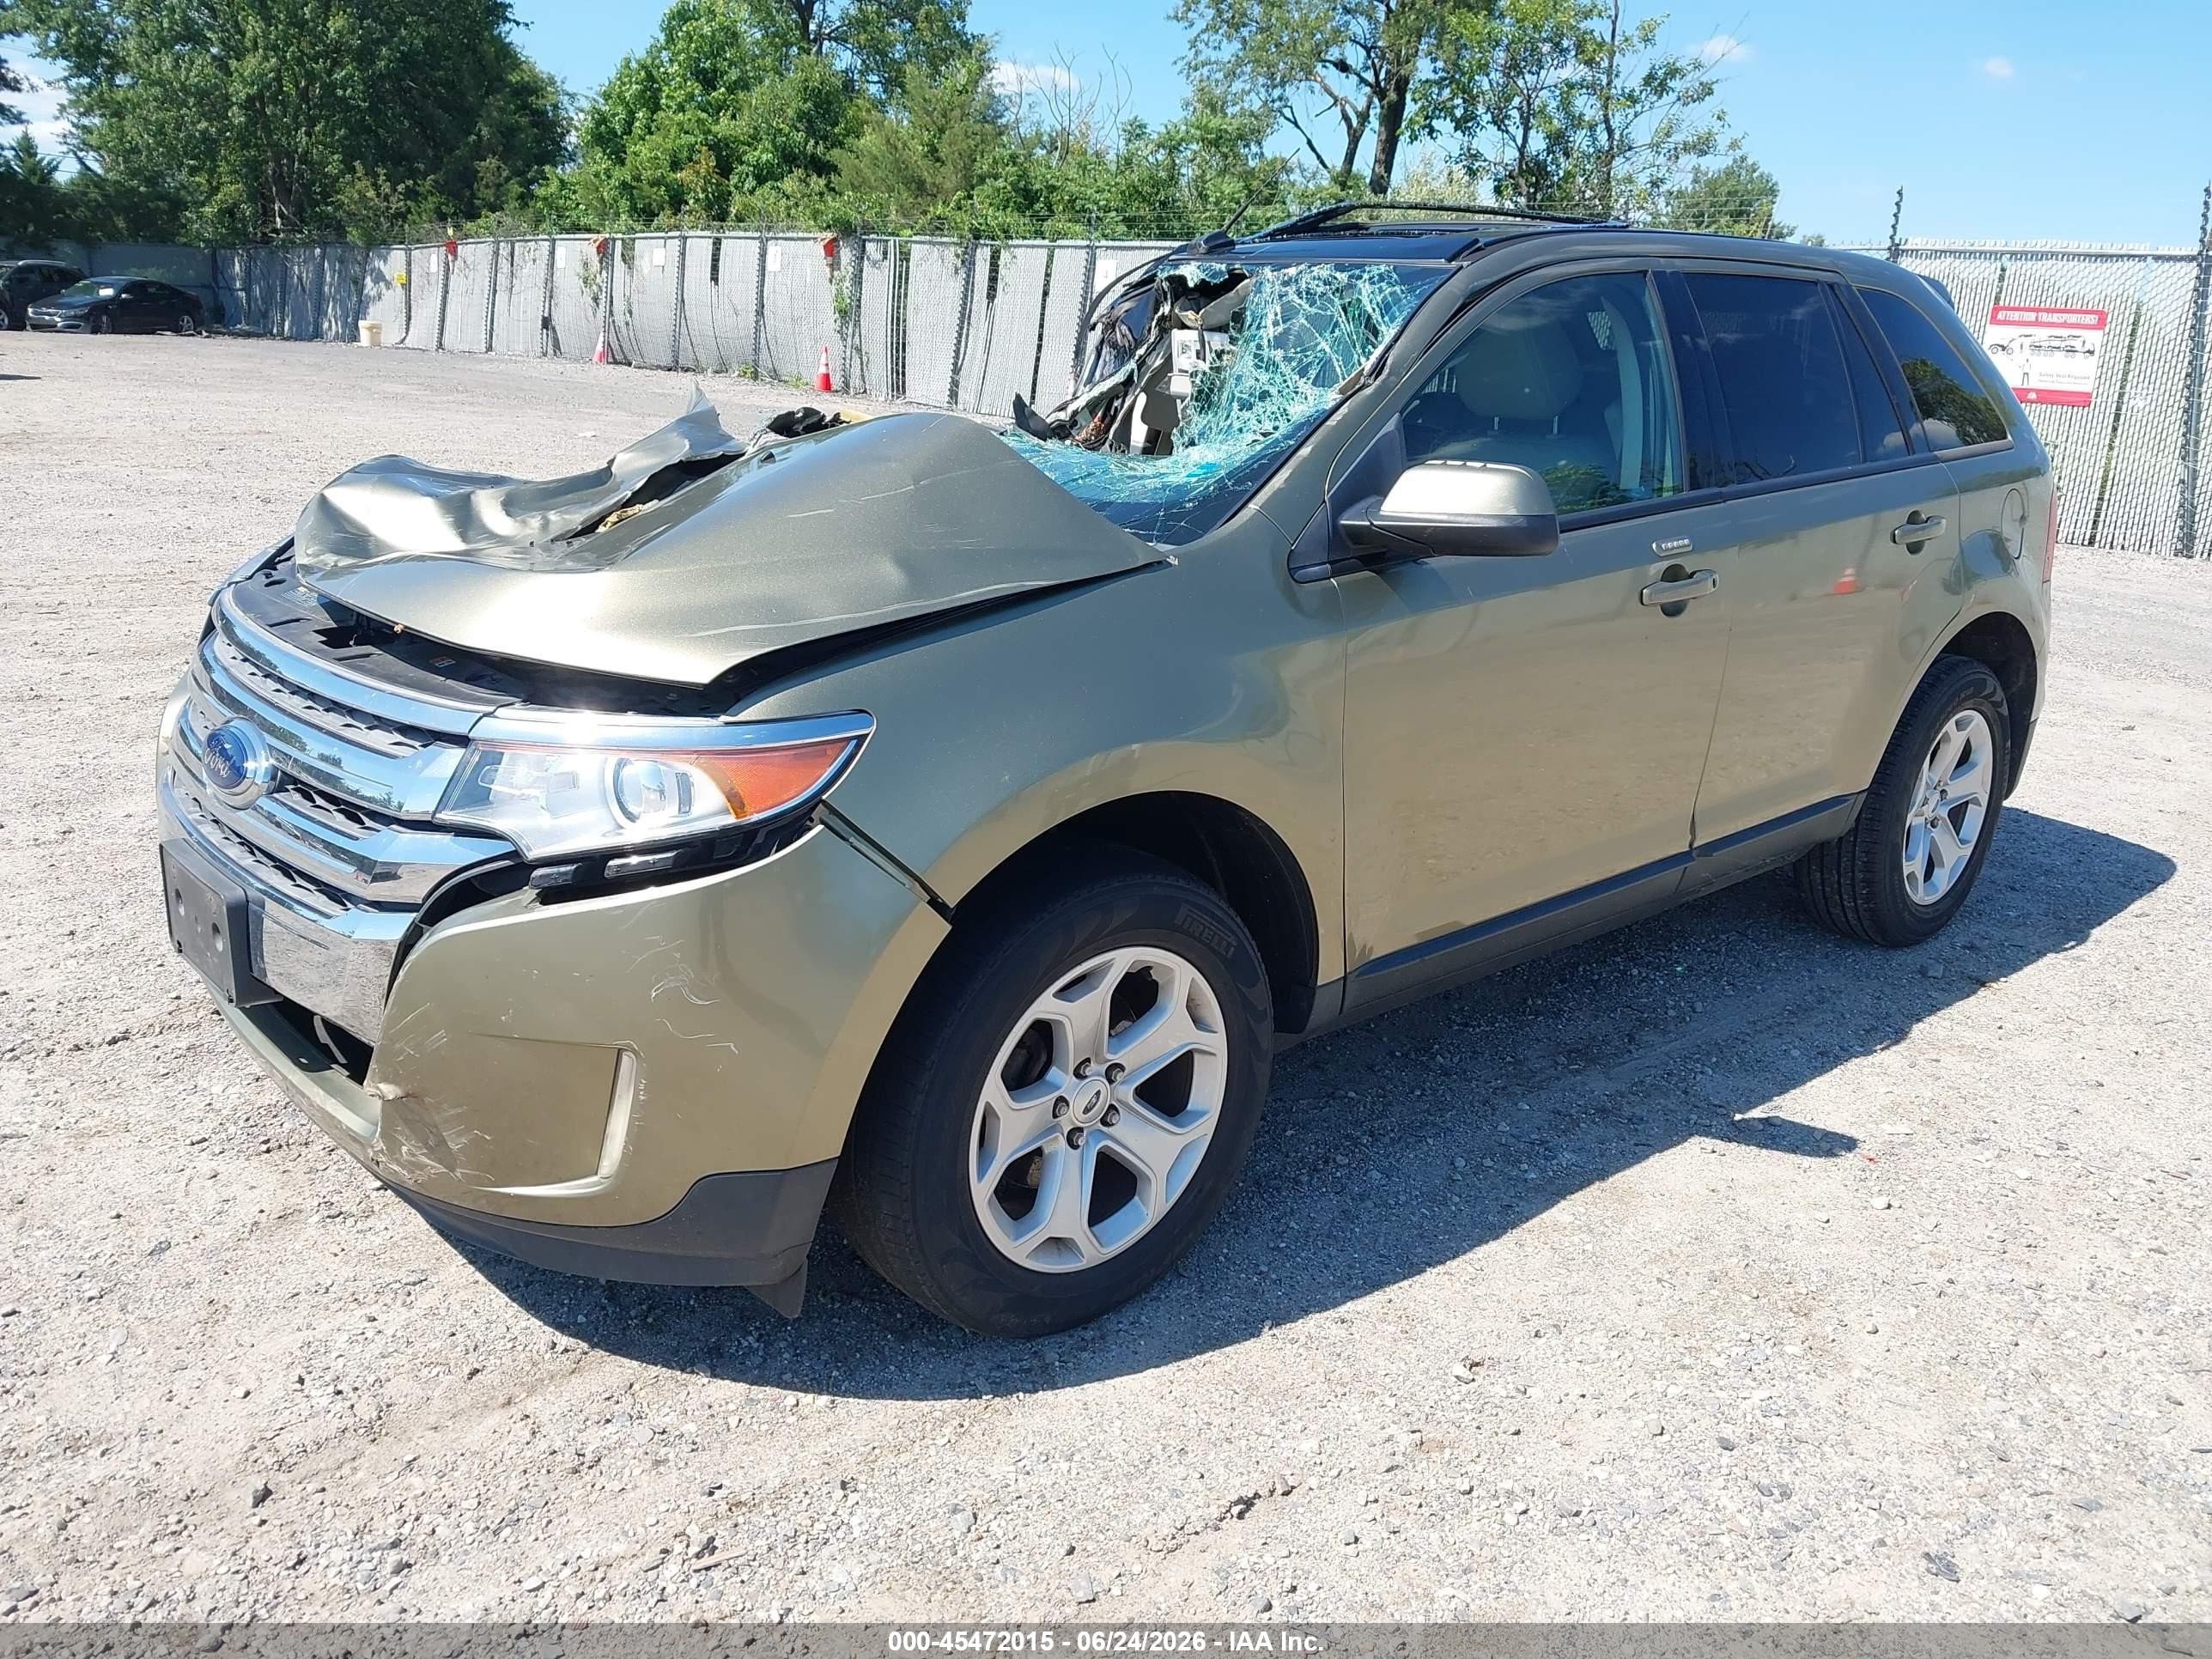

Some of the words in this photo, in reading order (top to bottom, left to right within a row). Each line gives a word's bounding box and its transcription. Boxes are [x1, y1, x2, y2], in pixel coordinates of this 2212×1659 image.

[1996, 310, 2037, 322] ATTENTION
[2038, 312, 2099, 325] TRANSPORTERS!
[1174, 902, 1237, 959] PIRELLI
